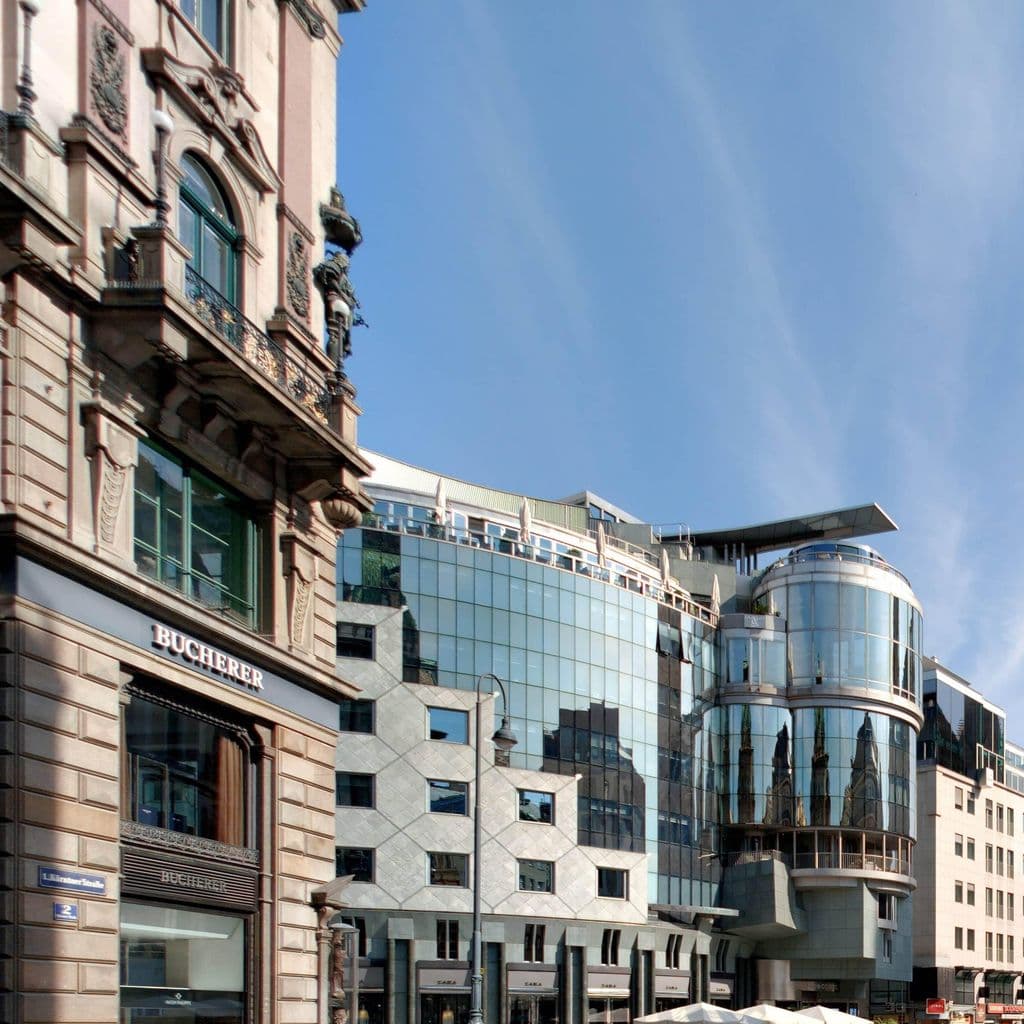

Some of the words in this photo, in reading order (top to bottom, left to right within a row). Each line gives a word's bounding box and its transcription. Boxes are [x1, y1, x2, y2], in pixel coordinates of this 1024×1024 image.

[153, 623, 265, 690] BUCHERER
[160, 870, 228, 893] BUCHERER
[62, 904, 72, 915] 2
